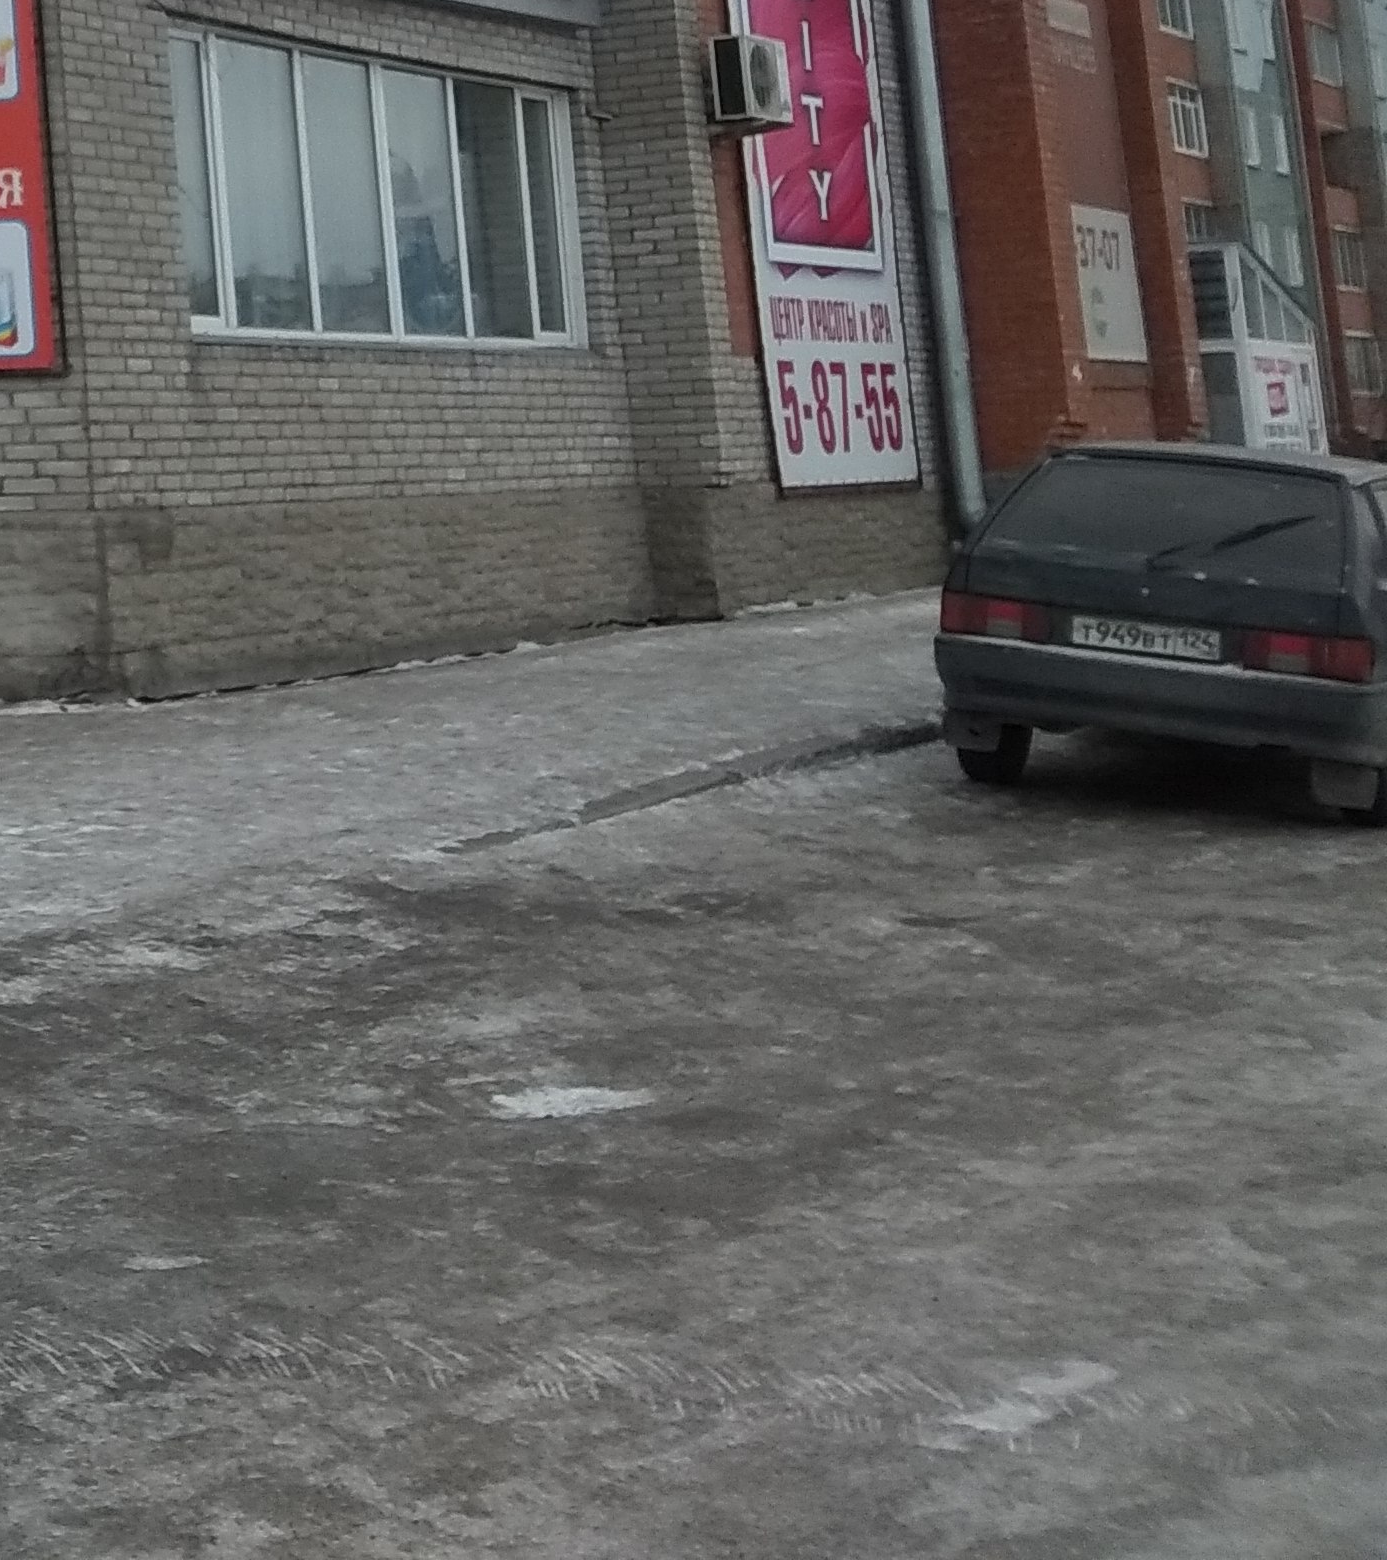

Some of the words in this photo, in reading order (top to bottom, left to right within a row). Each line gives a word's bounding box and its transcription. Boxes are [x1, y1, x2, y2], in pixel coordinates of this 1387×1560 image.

[769, 296, 804, 346] ЦЕНТР
[807, 299, 858, 343] КРАСОТЫ
[870, 302, 893, 343] SPA
[777, 358, 903, 456] 5-87-55
